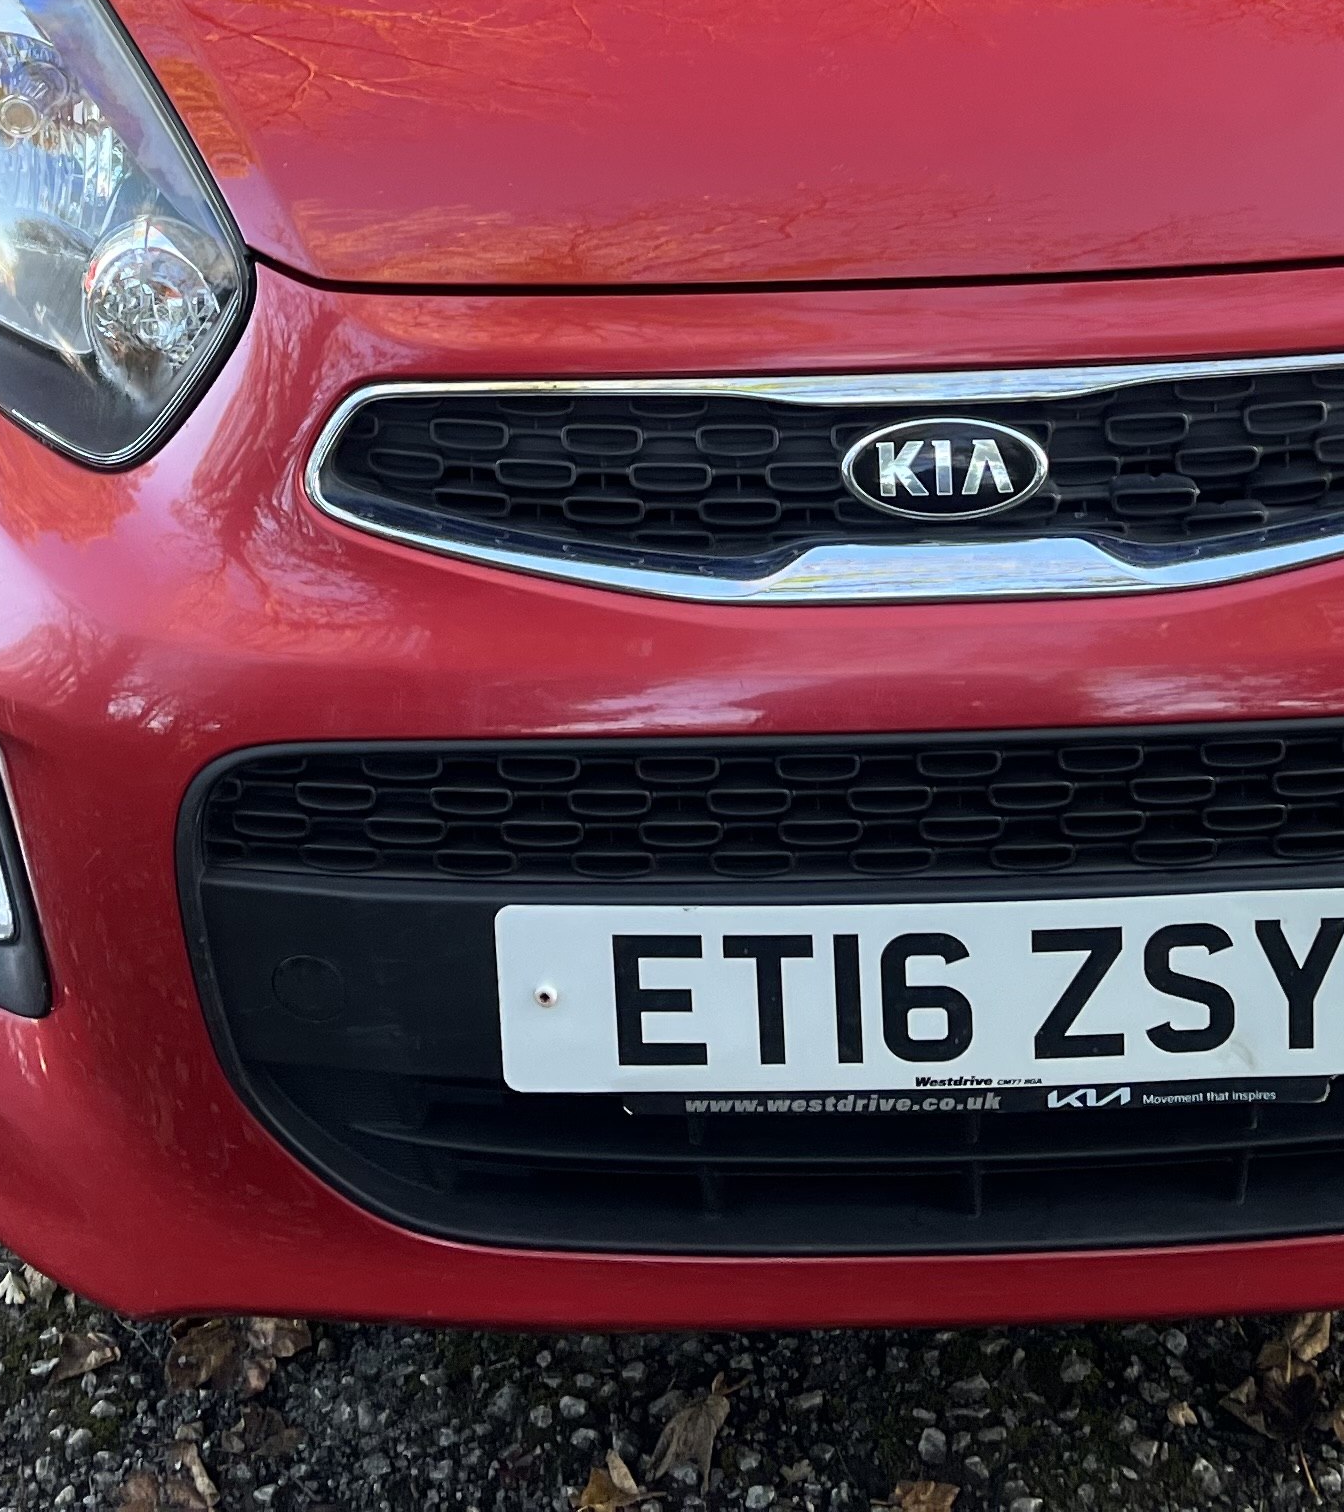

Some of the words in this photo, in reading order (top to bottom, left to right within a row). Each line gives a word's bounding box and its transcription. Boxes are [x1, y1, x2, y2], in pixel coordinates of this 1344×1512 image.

[876, 439, 1014, 497] KIA
[612, 932, 974, 1067] ET16
[915, 1075, 993, 1087] Westdrive
[685, 1092, 1002, 1113] www.westdrive.co.uk
[1143, 1092, 1204, 1105] Movement
[1207, 1091, 1229, 1102] that
[1232, 1090, 1277, 1102] inspires
